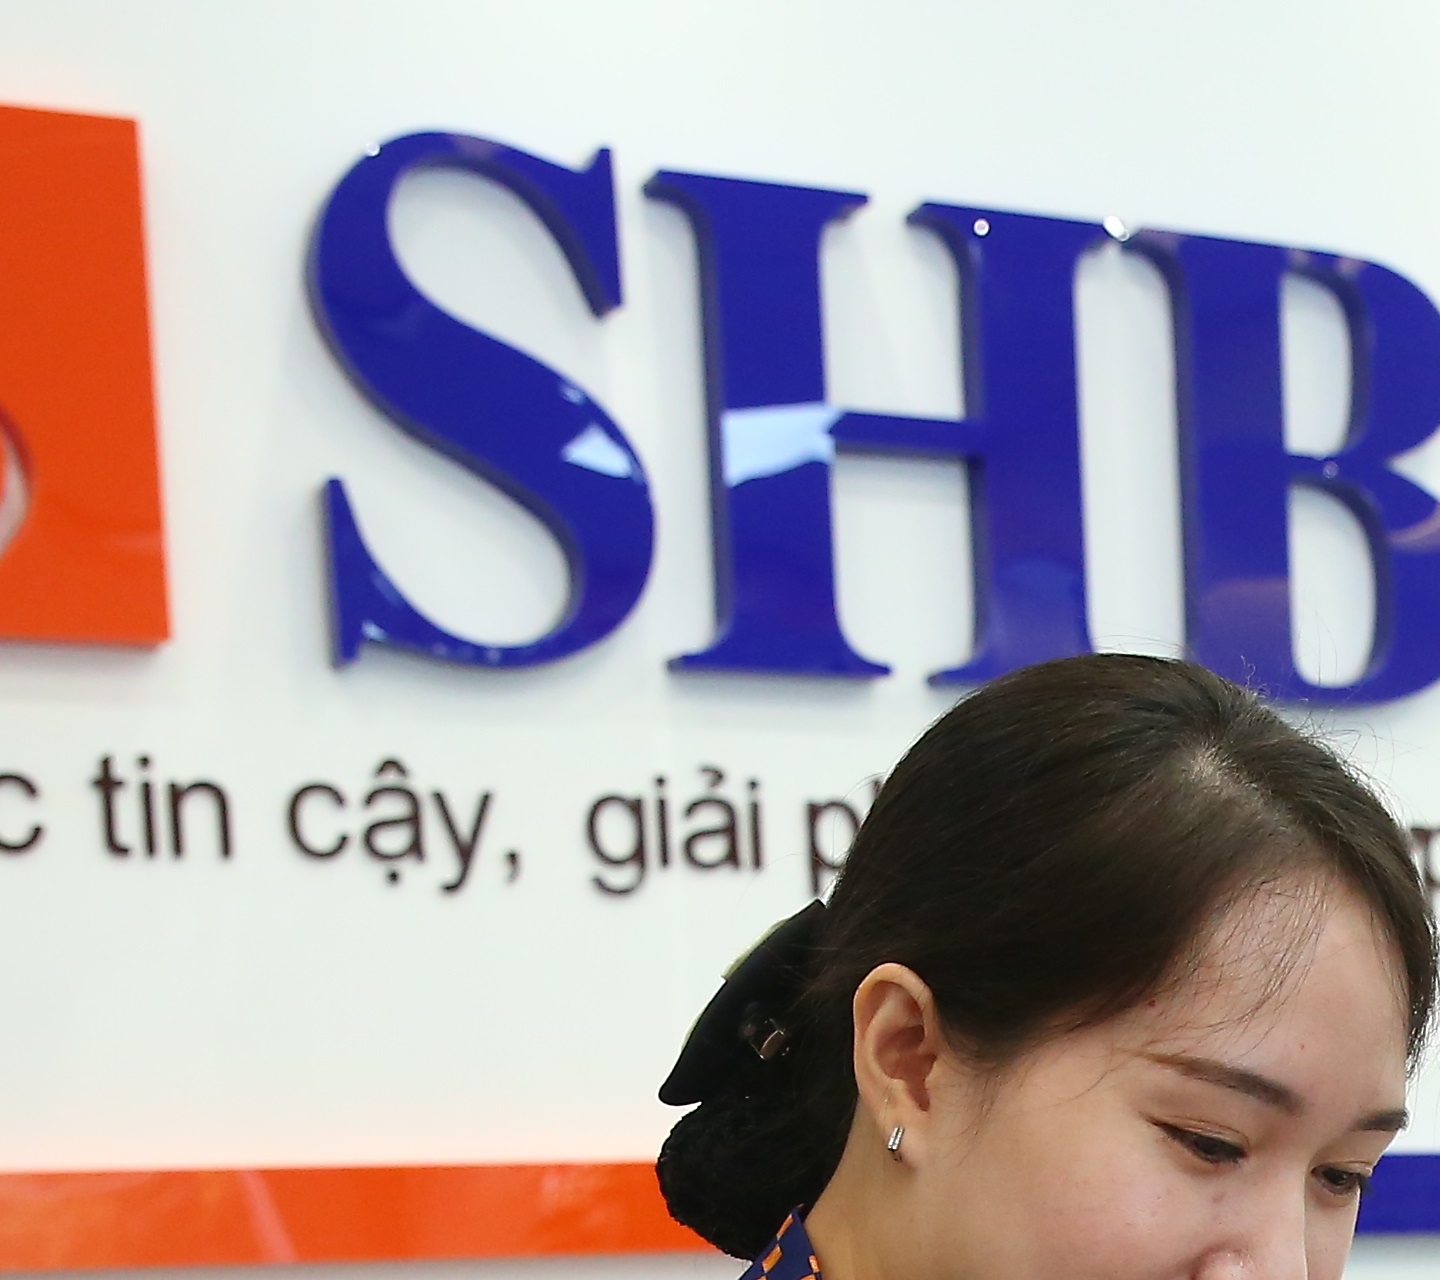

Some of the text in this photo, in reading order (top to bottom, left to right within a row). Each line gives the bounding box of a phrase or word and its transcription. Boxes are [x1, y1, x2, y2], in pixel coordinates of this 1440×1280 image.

[91, 753, 232, 860] tin
[286, 757, 521, 895] cậy,
[585, 766, 765, 896] giải
